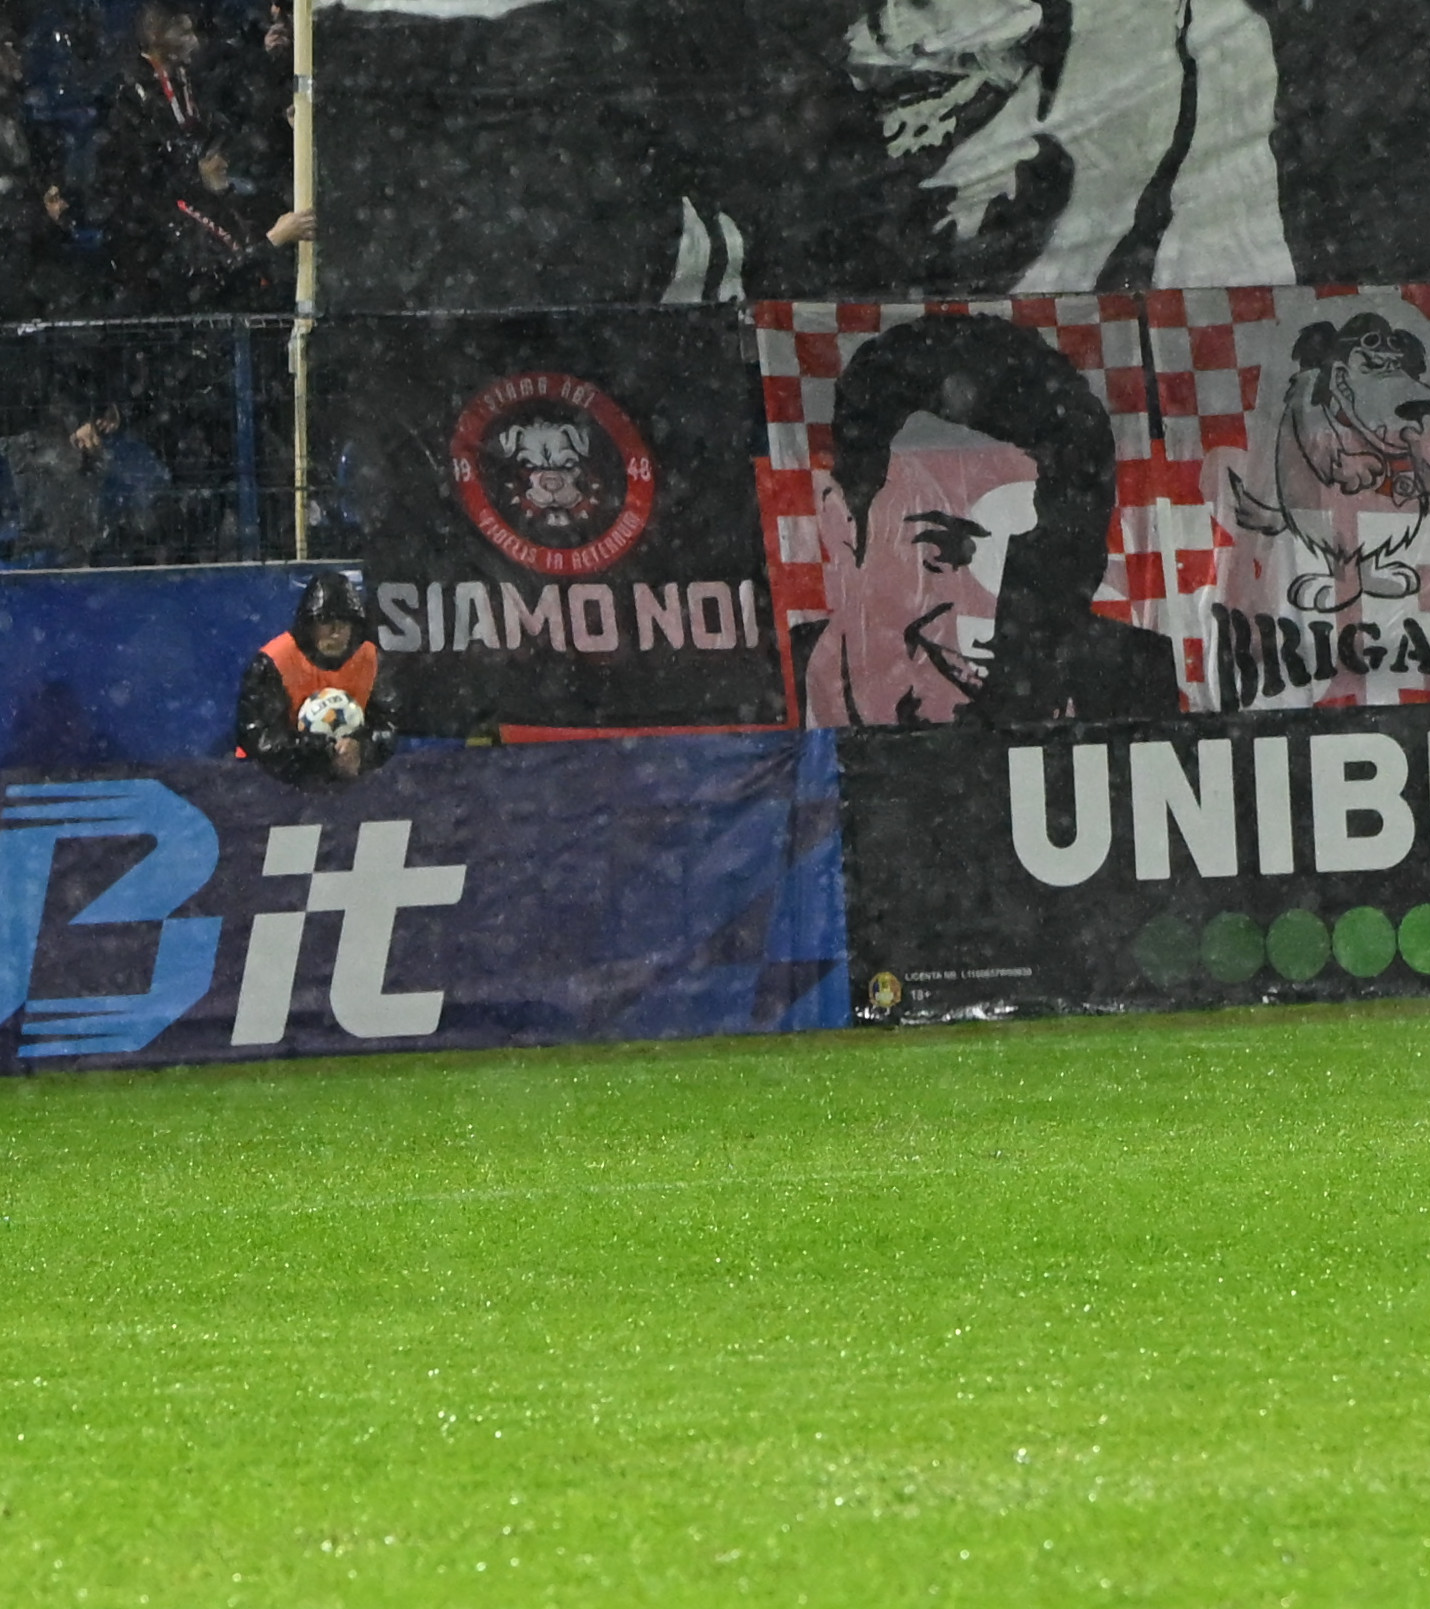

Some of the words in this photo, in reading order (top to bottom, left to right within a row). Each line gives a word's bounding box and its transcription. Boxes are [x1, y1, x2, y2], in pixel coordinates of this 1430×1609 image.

[627, 456, 652, 482] 48
[377, 582, 619, 652] SIAMO
[632, 579, 759, 652] NOI
